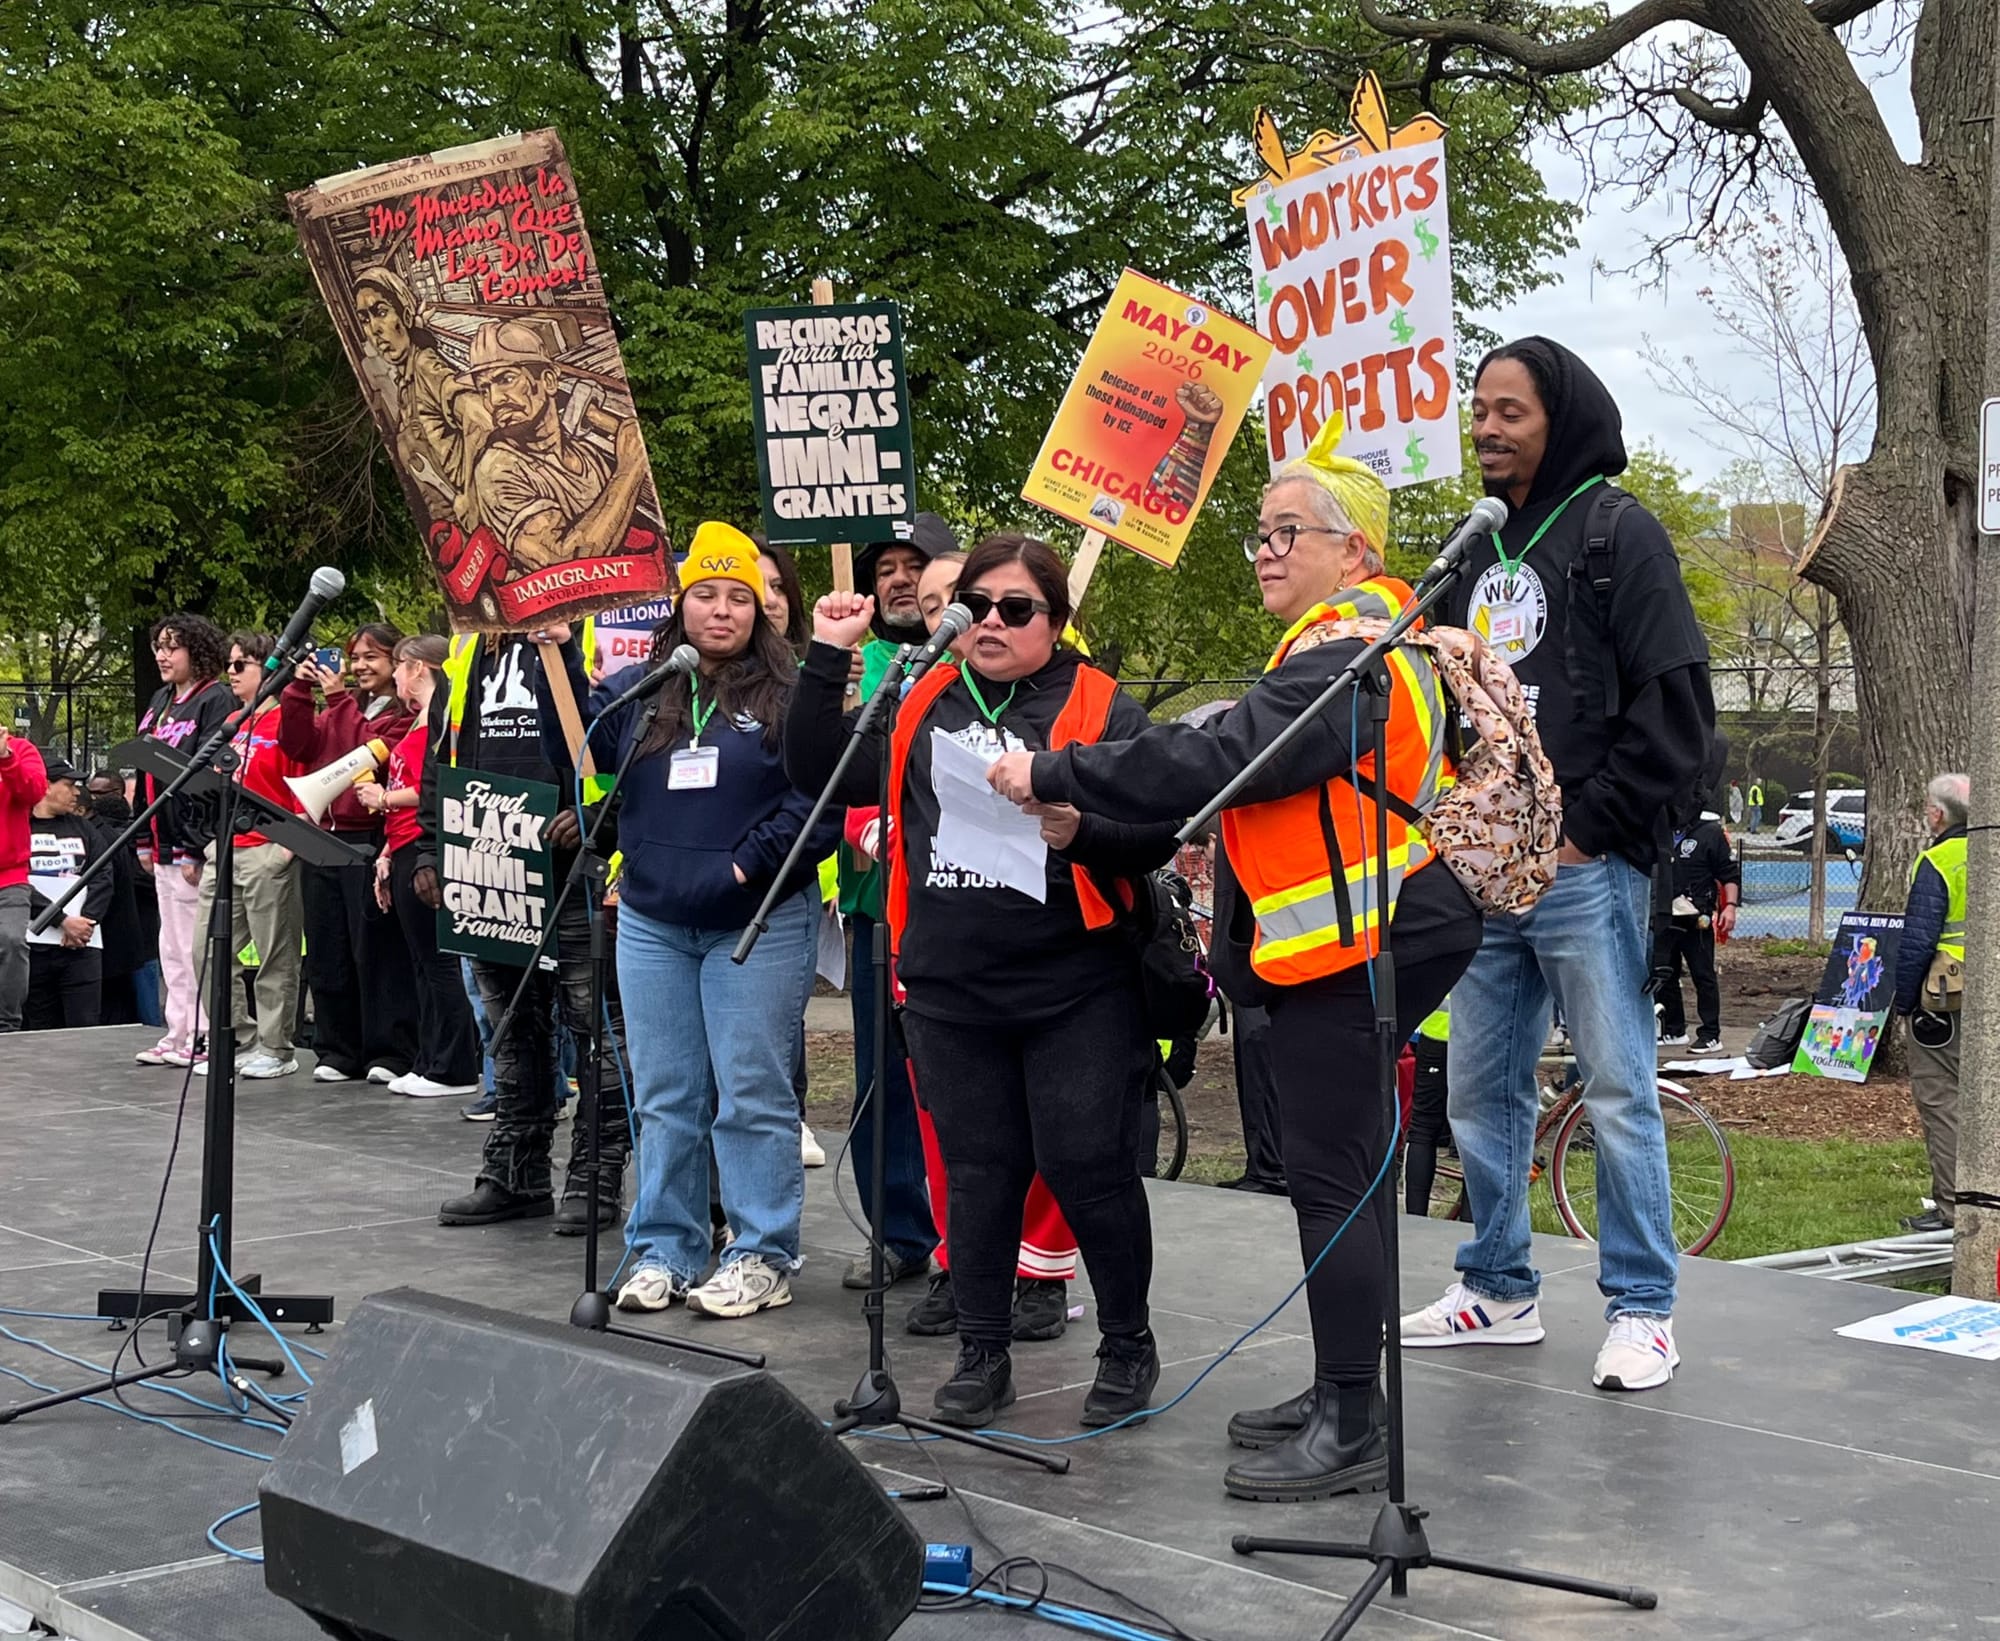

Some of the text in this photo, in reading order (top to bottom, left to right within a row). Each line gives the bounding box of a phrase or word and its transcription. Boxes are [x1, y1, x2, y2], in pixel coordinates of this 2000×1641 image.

[372, 182, 391, 194] THE
[391, 174, 420, 189] HAND
[420, 165, 452, 181] THAT
[455, 160, 486, 175] FEEDS
[411, 178, 530, 226] Muerdan
[410, 201, 572, 262] Mano Que
[448, 228, 580, 283] Les Da De
[482, 252, 587, 302] Comer!
[1269, 238, 1415, 355] OVER
[756, 315, 892, 349] RECURSOS
[1122, 299, 1252, 374] MAY DAY
[776, 338, 878, 370] para las
[1142, 341, 1205, 380] 2026
[761, 359, 896, 394] FAMILIAS
[1100, 370, 1168, 408] Release of all
[763, 391, 899, 432] NEGRAS
[1085, 384, 1114, 405] those
[1269, 337, 1451, 462] PROFITS
[827, 423, 844, 441] e
[1103, 411, 1133, 434] by ICE
[1051, 448, 1189, 526] CHICAGO
[1375, 466, 1392, 476] TICE
[773, 484, 907, 519] GRANTES
[458, 557, 479, 591] MADE
[513, 561, 634, 603] IMMIGRANT
[544, 583, 601, 603] WORKERS
[601, 603, 673, 625] BILLIONA
[612, 637, 654, 658] DEF
[488, 727, 517, 738] Racial
[463, 780, 528, 815] Fund
[443, 797, 546, 852] BLACK
[34, 839, 55, 847] AISE
[471, 836, 512, 857] and
[35, 857, 69, 867] FLOOR
[443, 843, 544, 893] IMMI-
[925, 872, 958, 888] FOR
[443, 882, 546, 927] GRANT
[452, 910, 543, 946] Families
[1888, 918, 1904, 929] DO
[1811, 1055, 1856, 1070] TOGETHER
